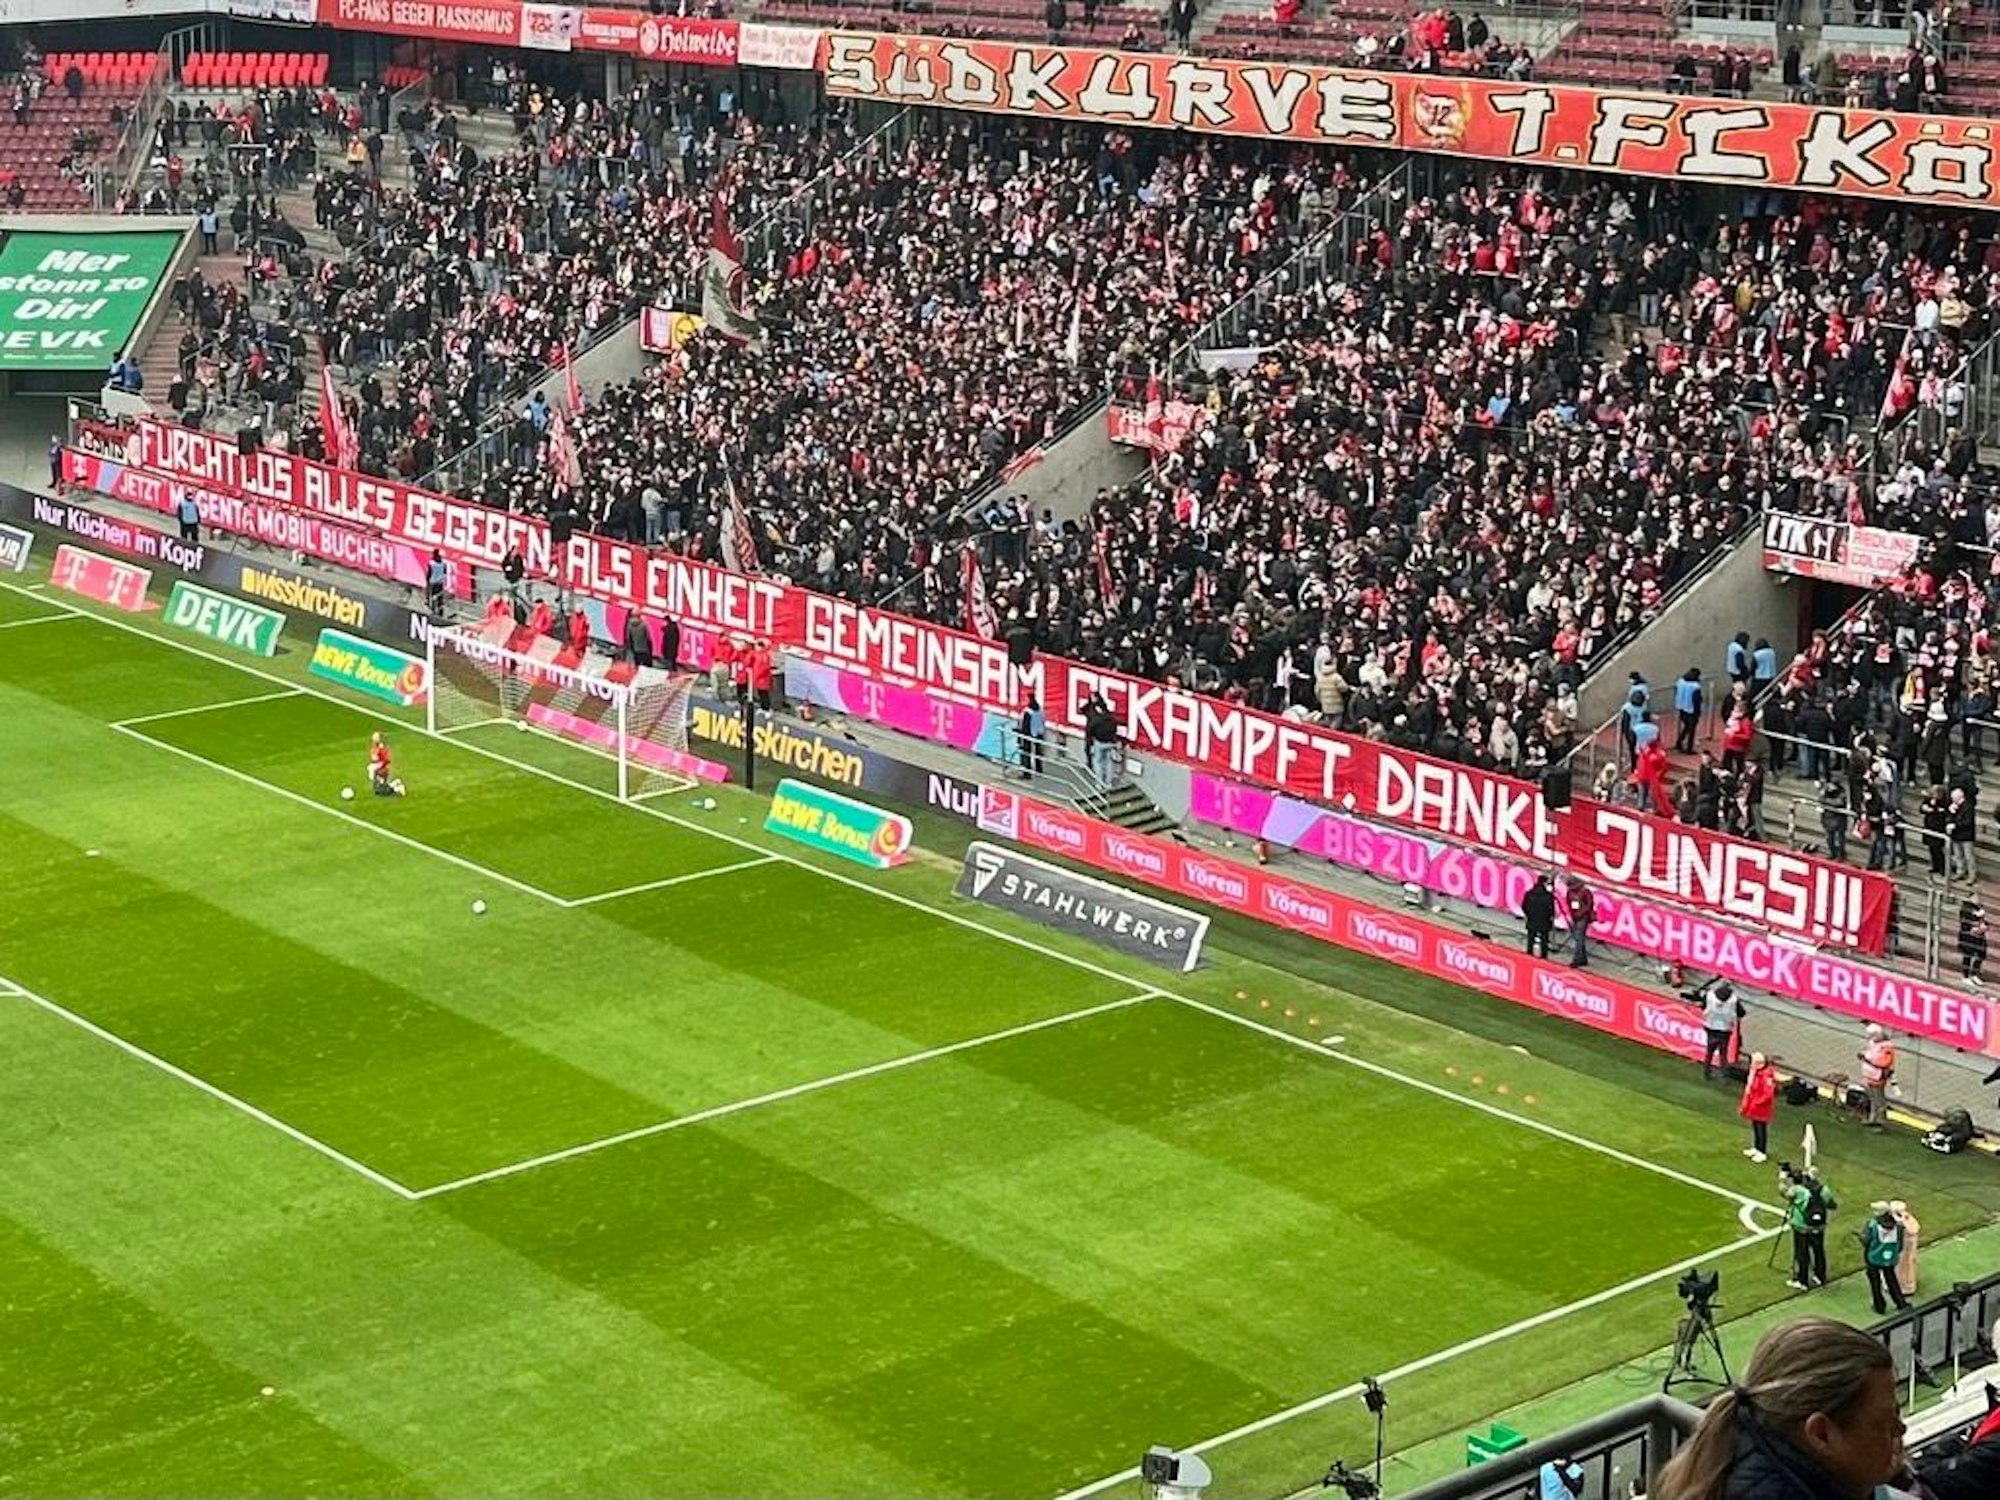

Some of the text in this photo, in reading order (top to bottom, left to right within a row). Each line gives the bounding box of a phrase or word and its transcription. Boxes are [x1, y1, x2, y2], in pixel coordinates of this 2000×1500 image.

[392, 2, 434, 28] GEGEN
[436, 5, 515, 34] RASSISMUS
[827, 33, 1398, 140] SÜDKURVE
[1799, 112, 1992, 199] KÖ
[1431, 104, 1452, 127] 12
[37, 249, 131, 273] Mer
[103, 276, 149, 293] zo
[13, 298, 109, 320] Dir!
[33, 497, 204, 573] Nur Küchen im Kopf
[119, 472, 394, 571] JETZT MGENTA MOBIL BUCHEN
[252, 567, 366, 628] wisskirchen
[173, 591, 266, 651] DEVK
[140, 420, 293, 502] FURCHTLOS
[304, 465, 395, 530] ALLES
[566, 534, 633, 600] ALS
[647, 556, 784, 636] EINHEIT
[806, 594, 1045, 711] GEMEINSAM
[1377, 756, 1567, 865] DANKE
[1594, 812, 1864, 947] JUNGS!!!
[313, 642, 398, 690] REWE Bonus
[771, 796, 871, 851] REWE Bonus
[1028, 812, 1082, 848] Yörem
[1104, 836, 1163, 876] Yörem
[1184, 862, 1244, 899] Yörem
[1266, 888, 1329, 926] Yörem
[1323, 819, 1374, 867] BIS
[1379, 833, 1424, 882] ZU
[1592, 889, 1801, 989] CASHBACK
[1810, 962, 1987, 1041] ERHALTEN
[1351, 914, 1418, 957] Yörem
[1442, 944, 1511, 987] Yörem
[1539, 971, 1610, 1017] Yörem
